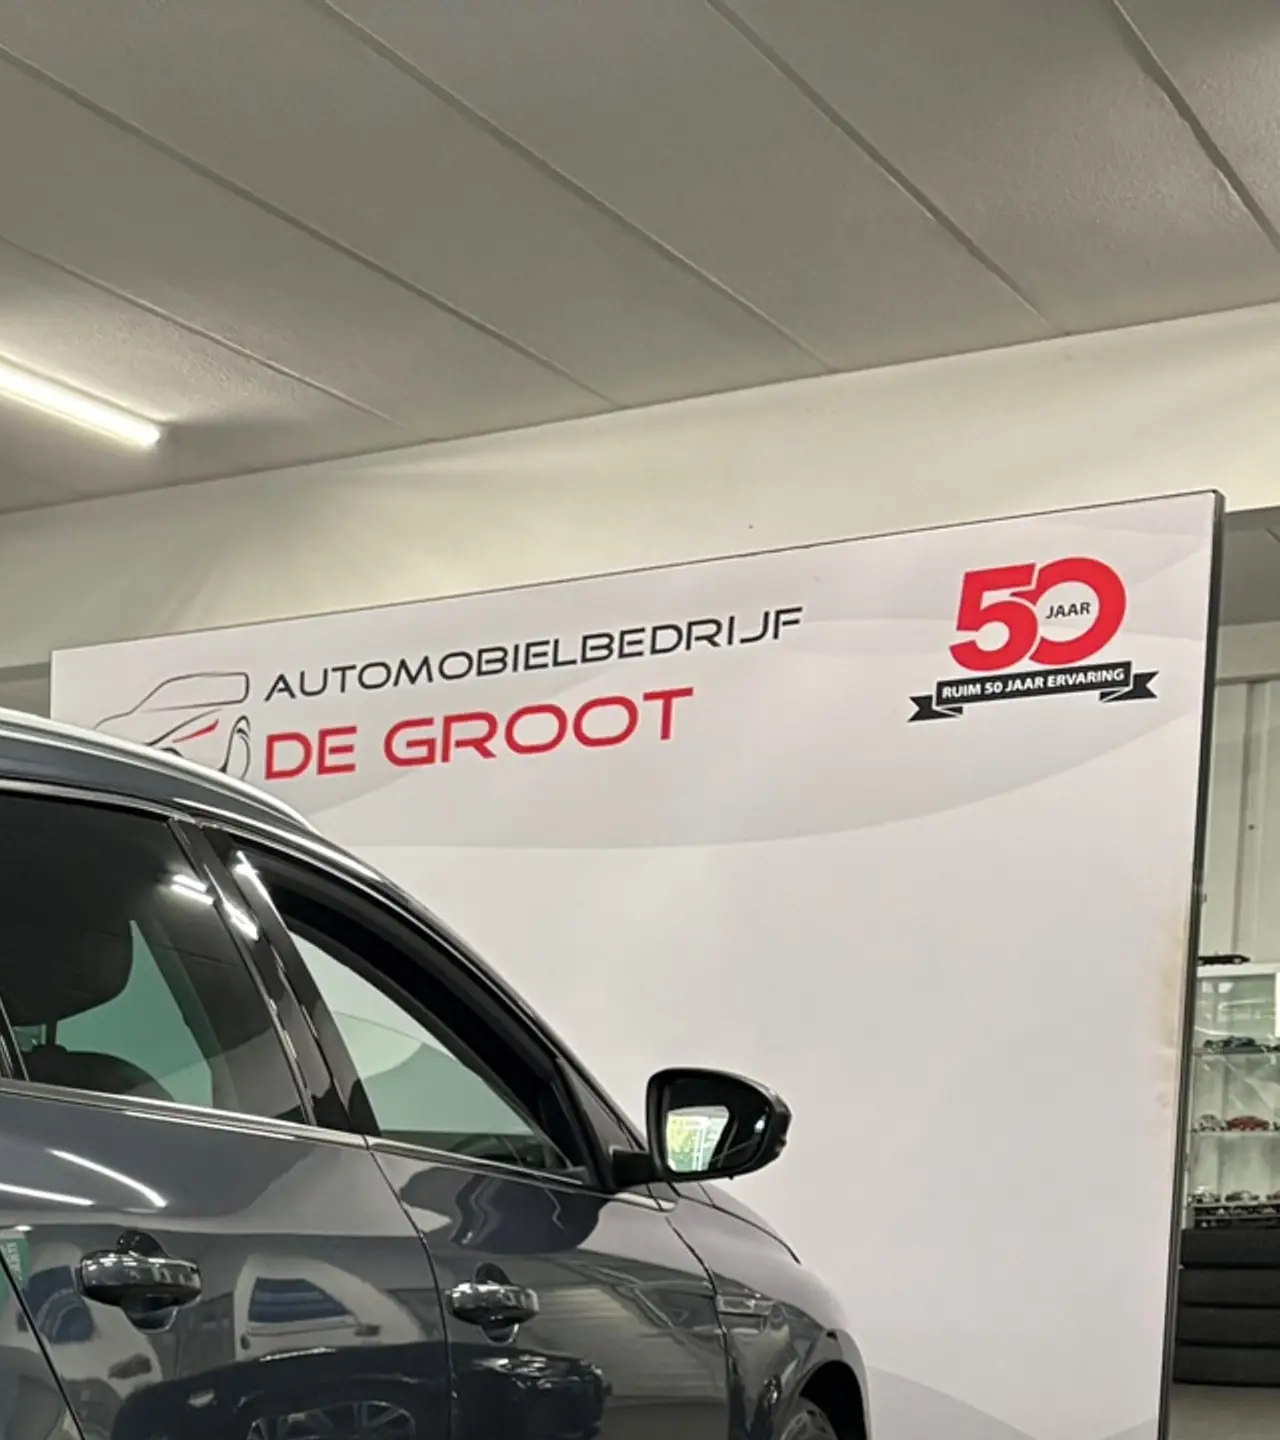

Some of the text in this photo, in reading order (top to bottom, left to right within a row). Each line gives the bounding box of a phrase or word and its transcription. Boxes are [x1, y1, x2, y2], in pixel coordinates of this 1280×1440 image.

[264, 607, 803, 702] AUTOMOBIELBEDRIJF
[949, 556, 1126, 672] 50
[1045, 602, 1091, 619] JAAR
[942, 668, 1125, 699] RUIM 50 JAAR ERVARING
[264, 687, 694, 780] DE GROOT
